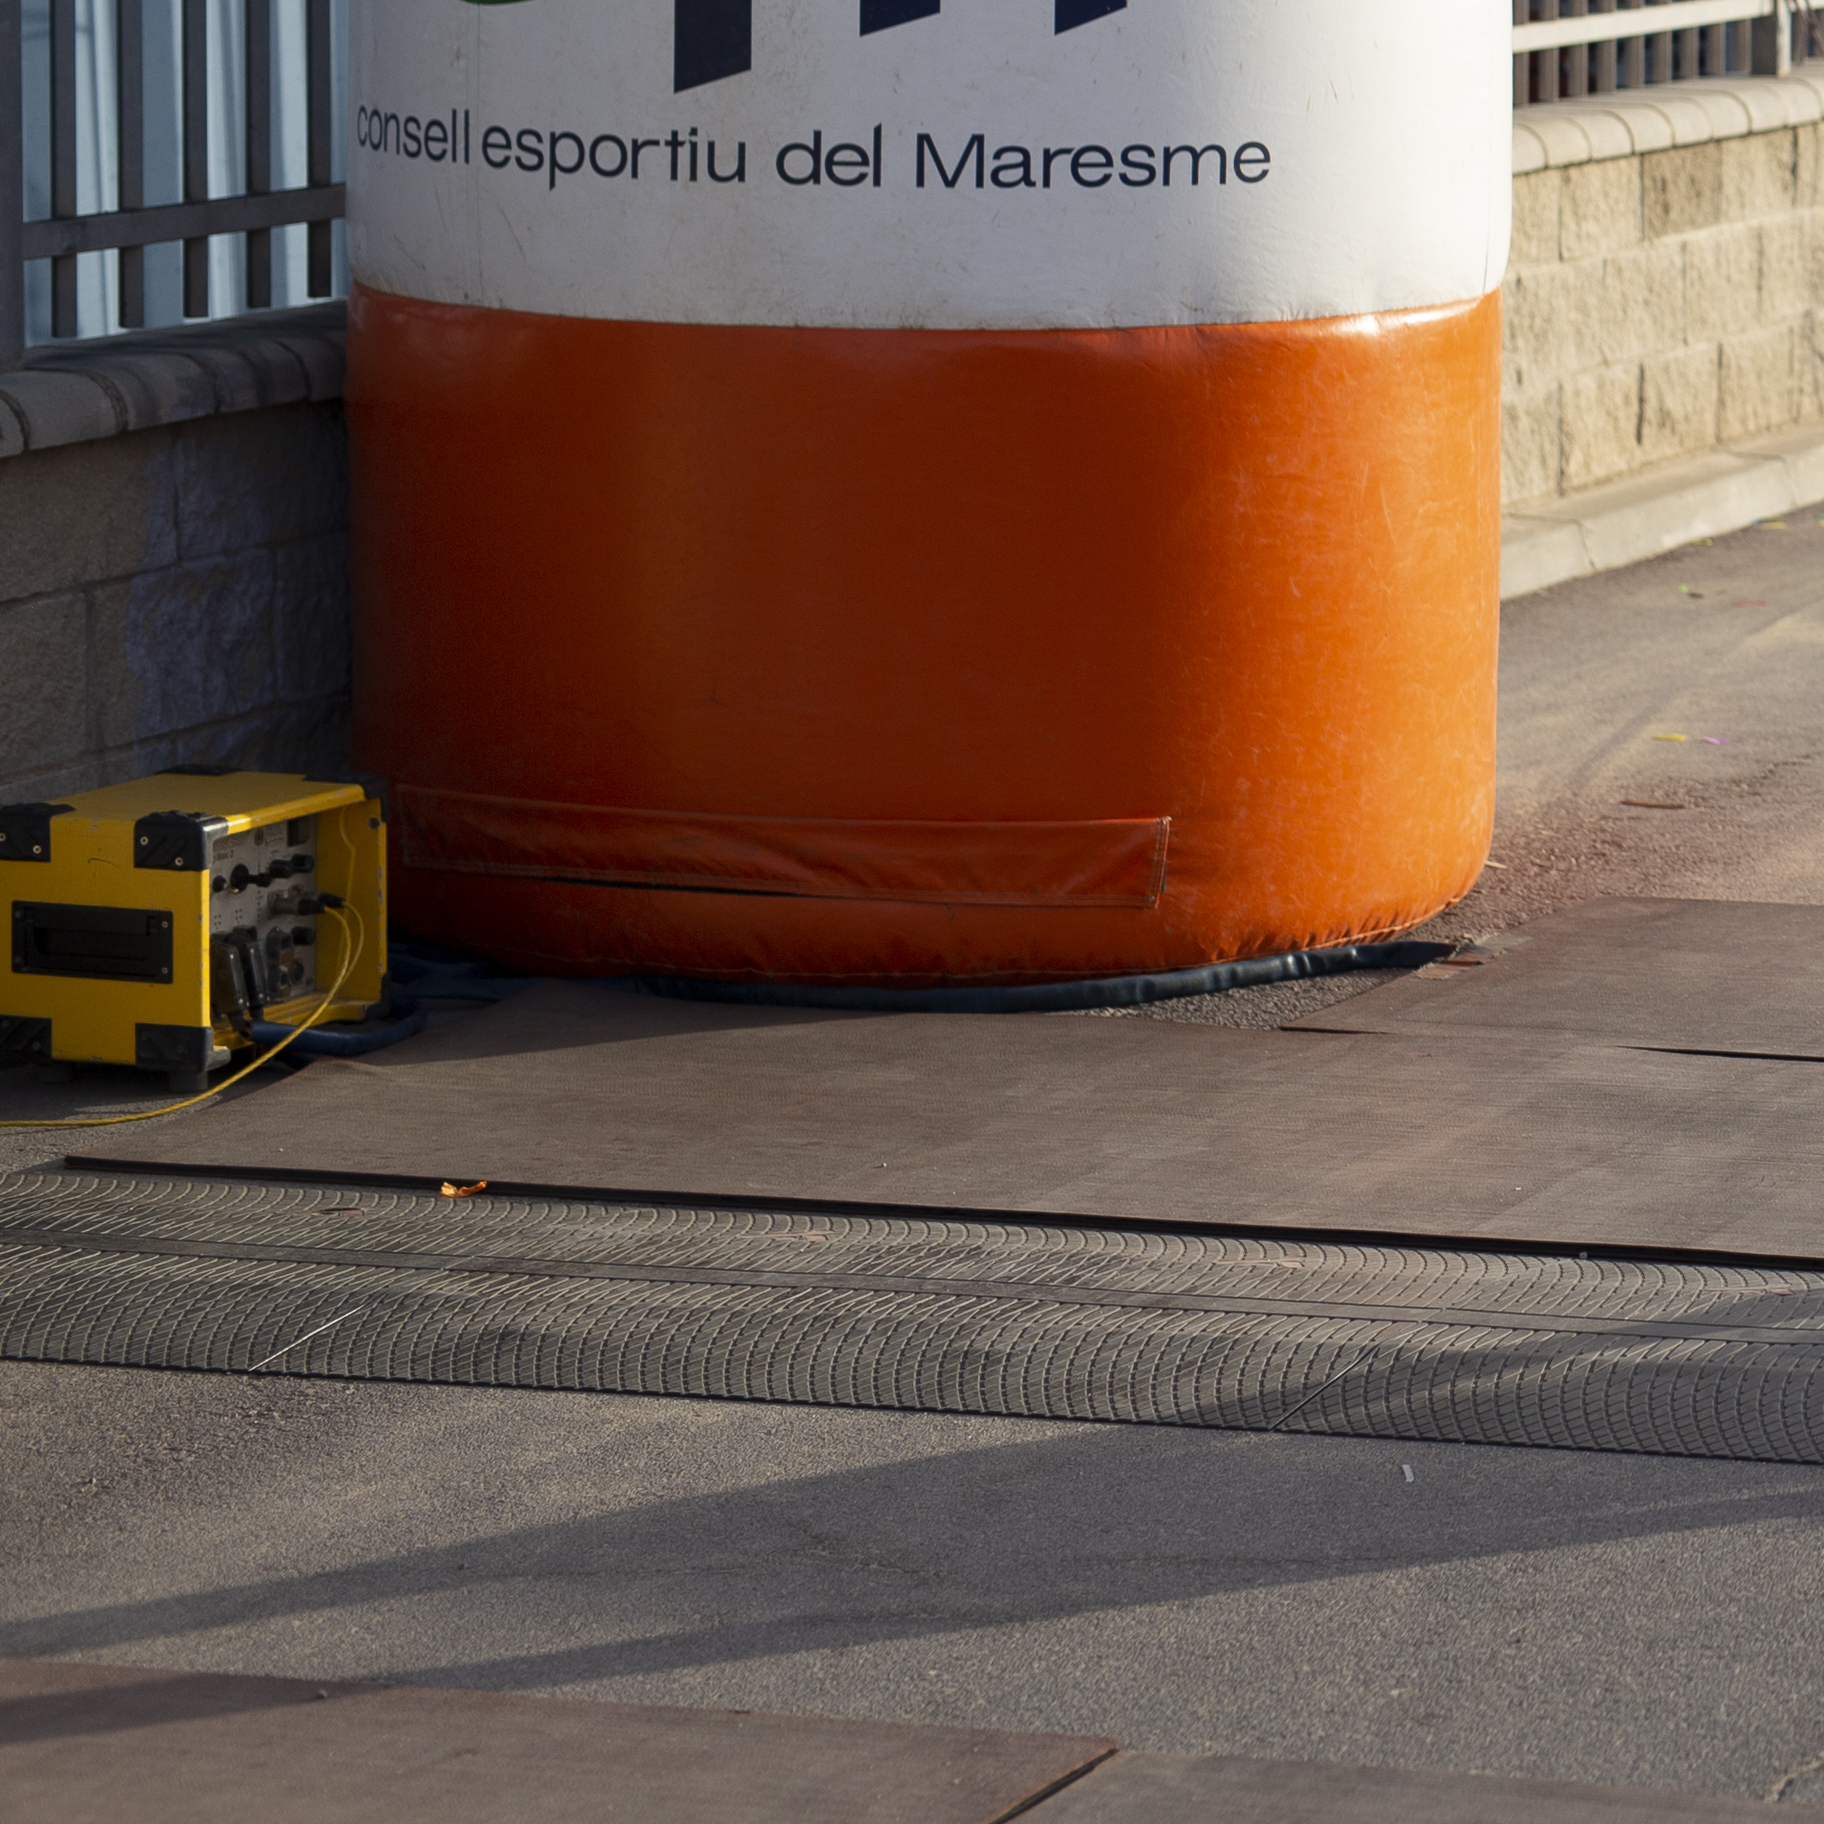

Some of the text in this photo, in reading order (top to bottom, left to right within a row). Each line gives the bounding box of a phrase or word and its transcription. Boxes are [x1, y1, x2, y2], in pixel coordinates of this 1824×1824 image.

[356, 104, 1271, 191] consell esportiu del Maresme
